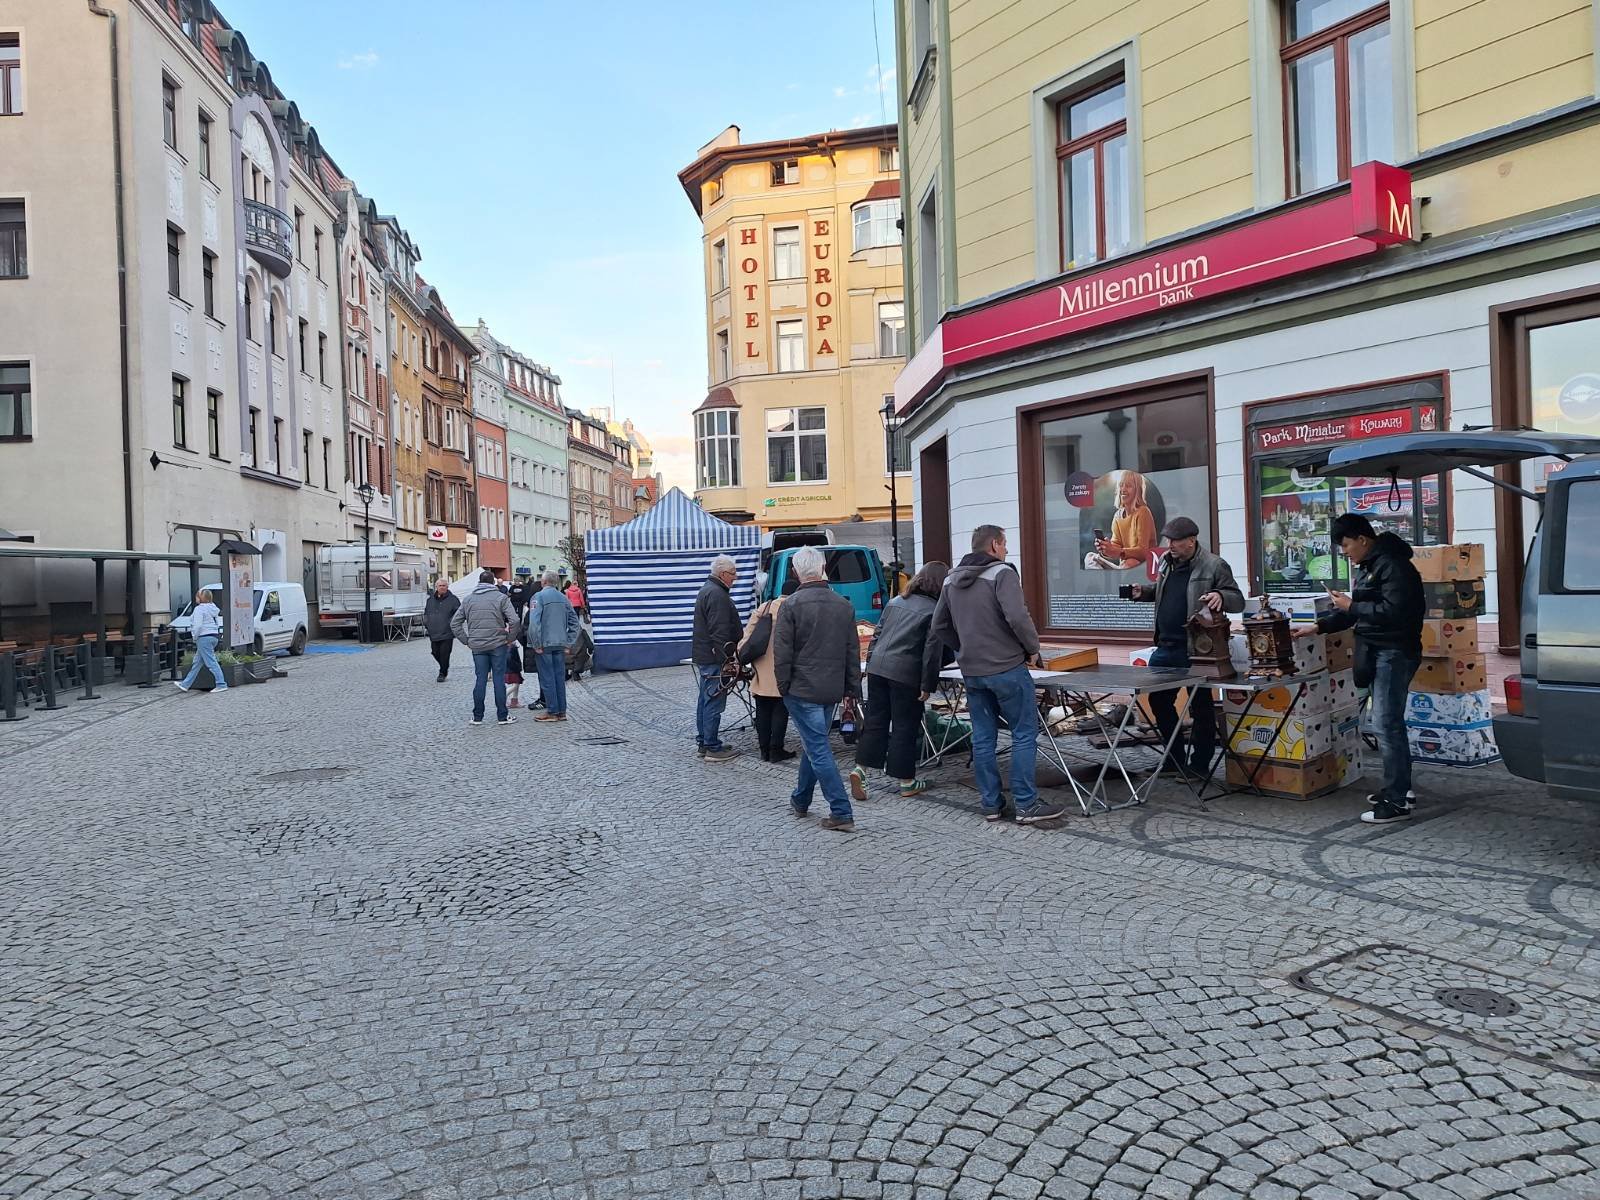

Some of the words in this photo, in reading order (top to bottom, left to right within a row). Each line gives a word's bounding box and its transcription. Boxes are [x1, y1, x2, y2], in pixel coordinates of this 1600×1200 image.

[1387, 189, 1412, 239] M
[740, 228, 760, 358] HOTEL
[813, 219, 834, 355] EUROPA
[1058, 253, 1209, 318] Millennium
[1158, 284, 1194, 308] bank
[1262, 429, 1292, 447] Park
[1295, 424, 1345, 443] Miniatur
